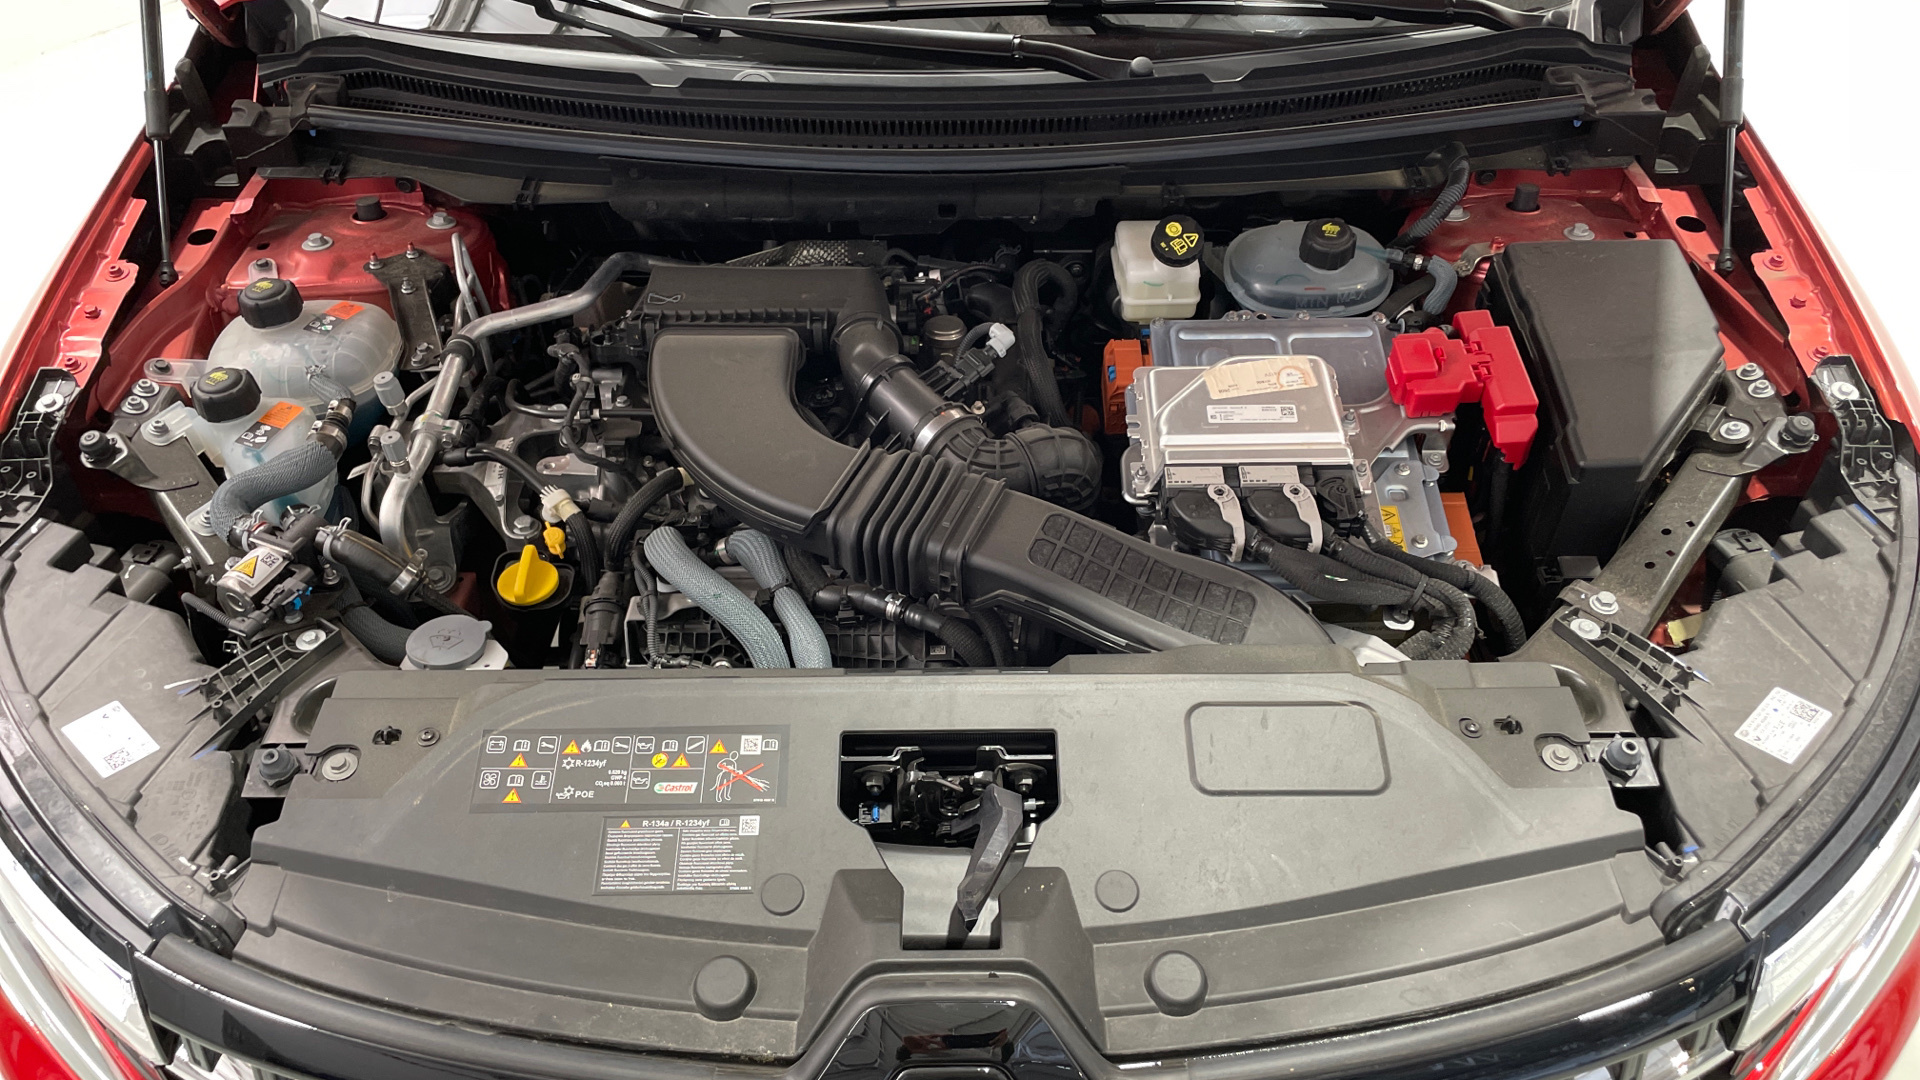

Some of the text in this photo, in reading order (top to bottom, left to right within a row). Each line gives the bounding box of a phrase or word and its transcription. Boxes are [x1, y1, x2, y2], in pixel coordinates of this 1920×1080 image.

[1337, 289, 1366, 304] MAX
[575, 759, 607, 768] R-1234yf
[664, 784, 693, 792] Castrol
[574, 790, 595, 798] POE
[675, 819, 710, 828] R-1234yf
